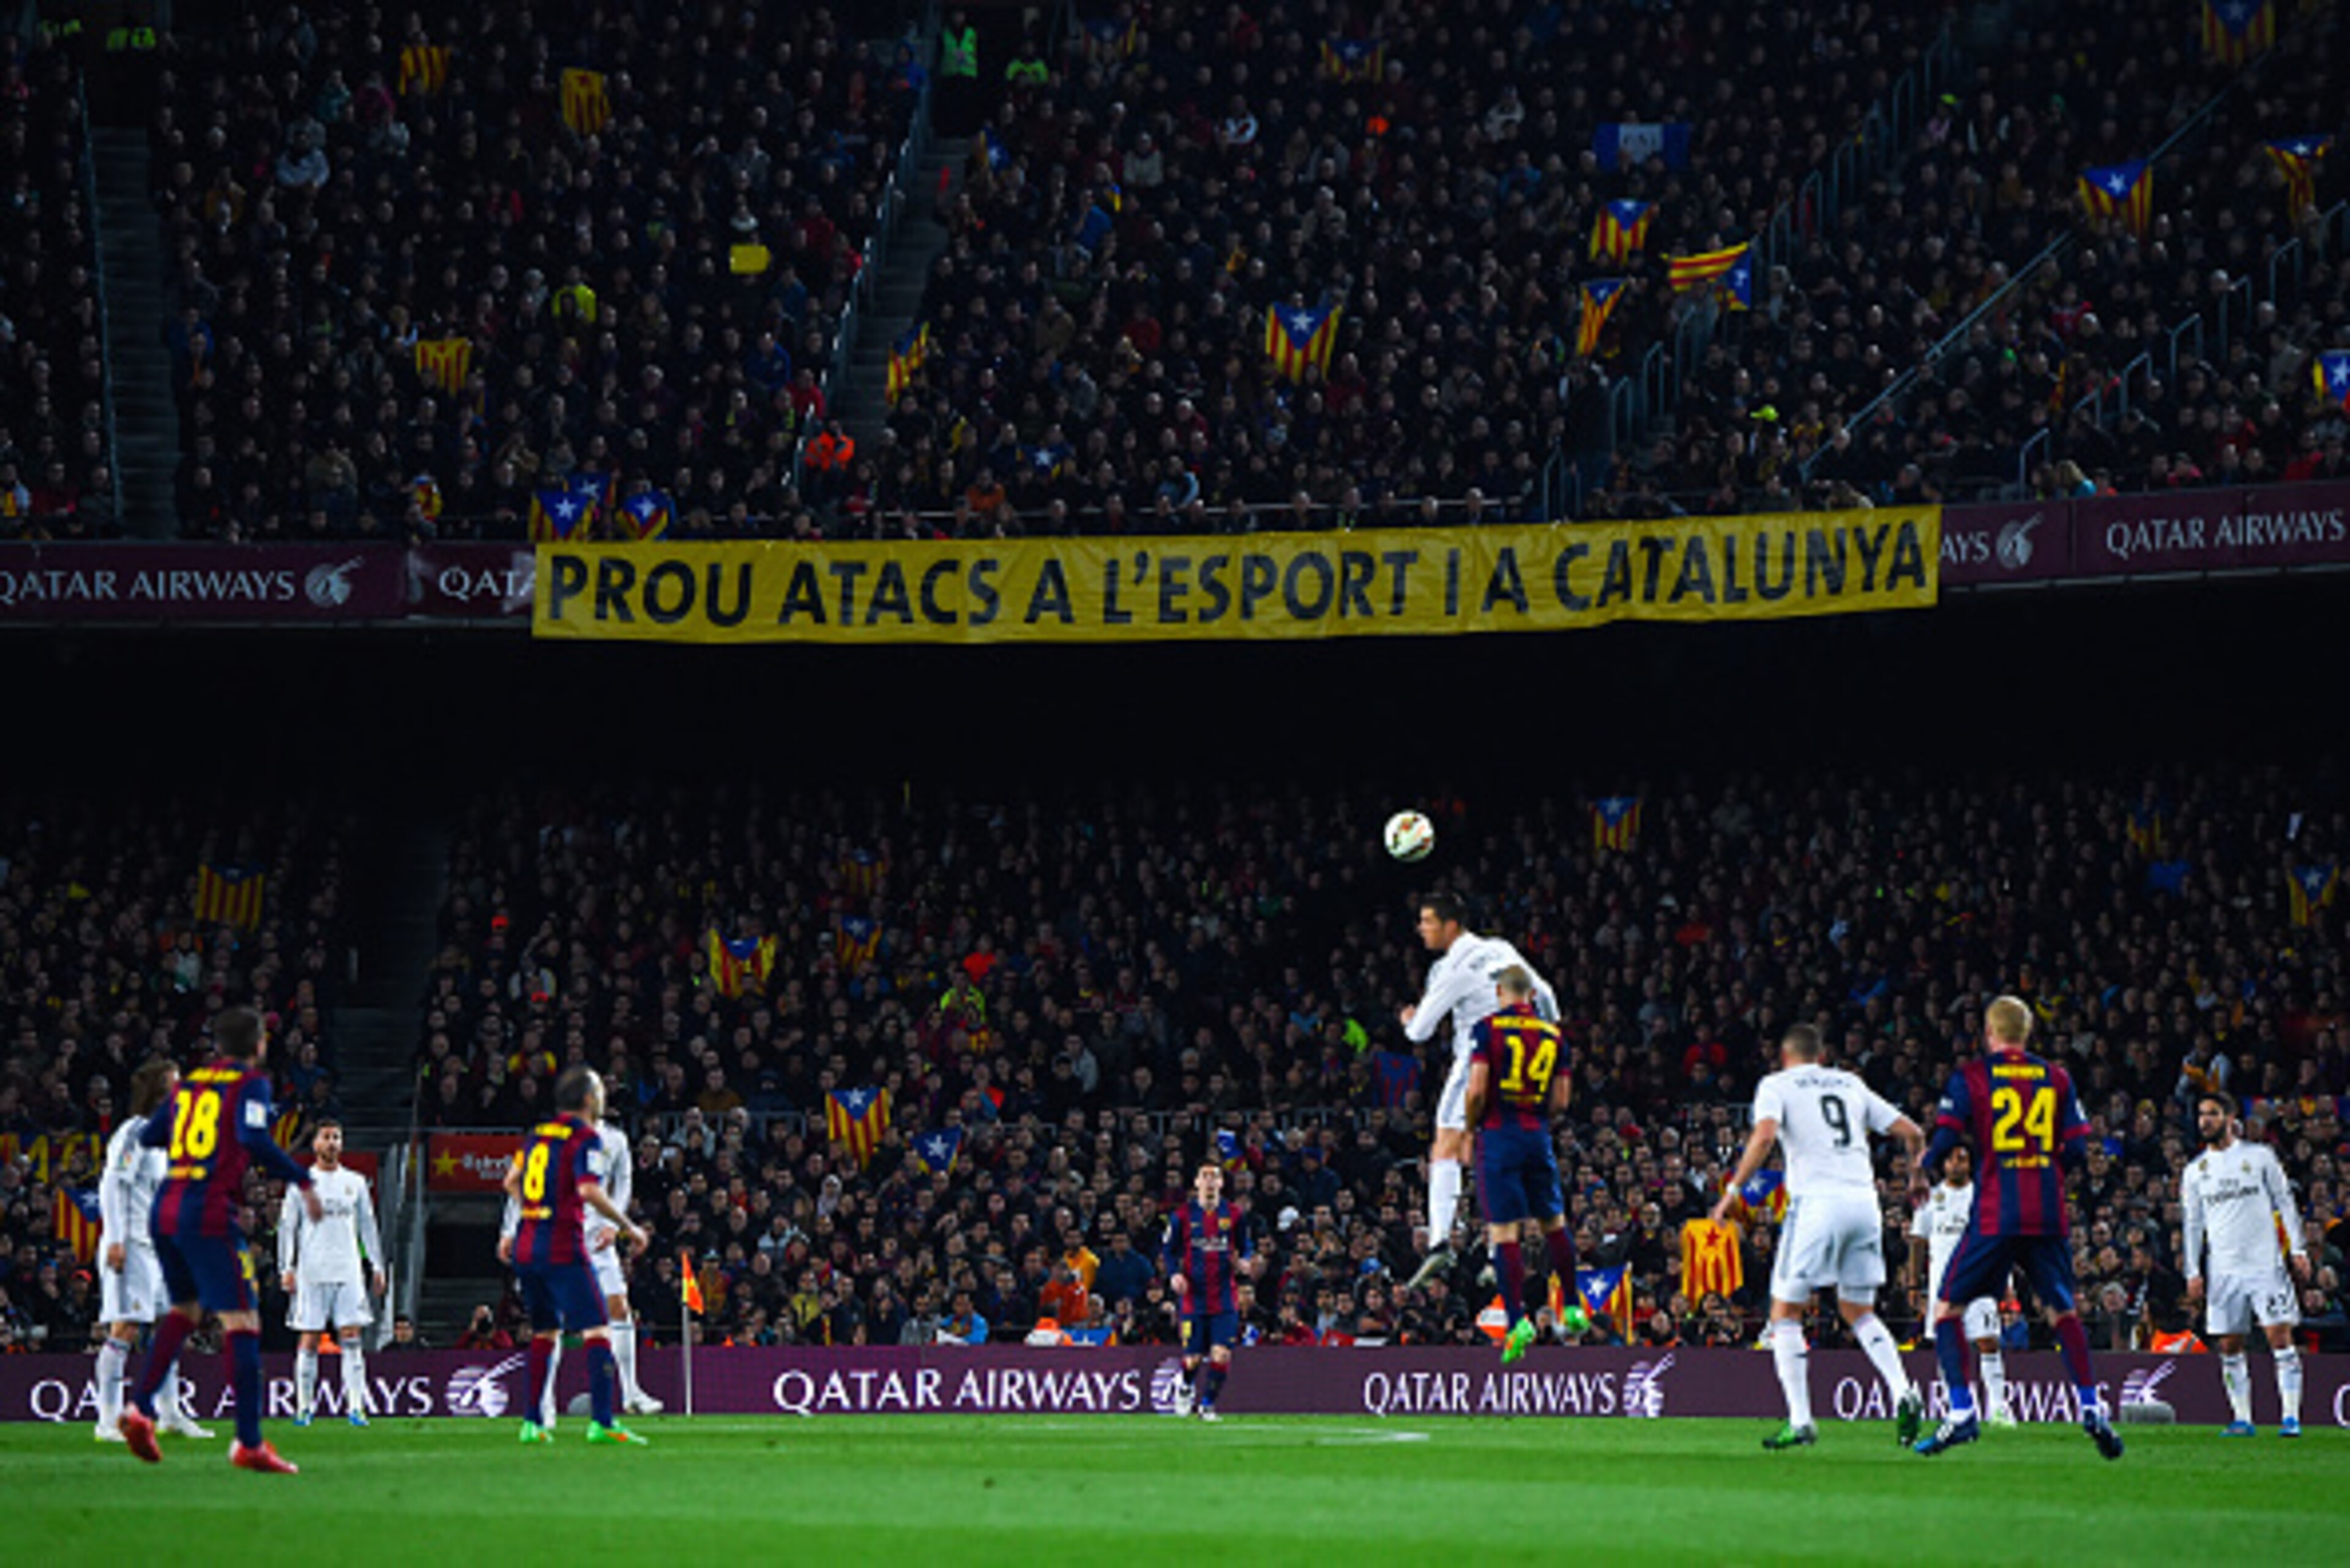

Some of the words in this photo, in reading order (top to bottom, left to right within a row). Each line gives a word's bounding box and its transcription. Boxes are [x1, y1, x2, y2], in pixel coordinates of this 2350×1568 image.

[2106, 517, 2205, 561] QATAR
[2214, 509, 2346, 546] AIRWAYS
[0, 570, 118, 605] QATAR
[130, 570, 295, 600] AIRWAYS
[550, 554, 753, 626] PROU
[778, 559, 1001, 626] ATACS
[1024, 558, 1075, 624] A
[1103, 550, 1418, 624] L'ESPORT
[1444, 547, 1461, 616] I
[1481, 547, 1529, 613] A
[1553, 520, 1927, 611] CATALUNYA
[1499, 1034, 1557, 1093] 14
[169, 1089, 221, 1160] 18
[1819, 1094, 1851, 1148] 9
[1991, 1087, 2057, 1152] 24
[523, 1141, 549, 1201] 8
[29, 1379, 199, 1421] QAR
[772, 1369, 942, 1417] QATAR
[952, 1369, 1141, 1410] AIRWAYS
[1363, 1372, 1470, 1417] QATAR
[1479, 1372, 1616, 1413] AIRWAYS
[1833, 1377, 1950, 1421] QAR
